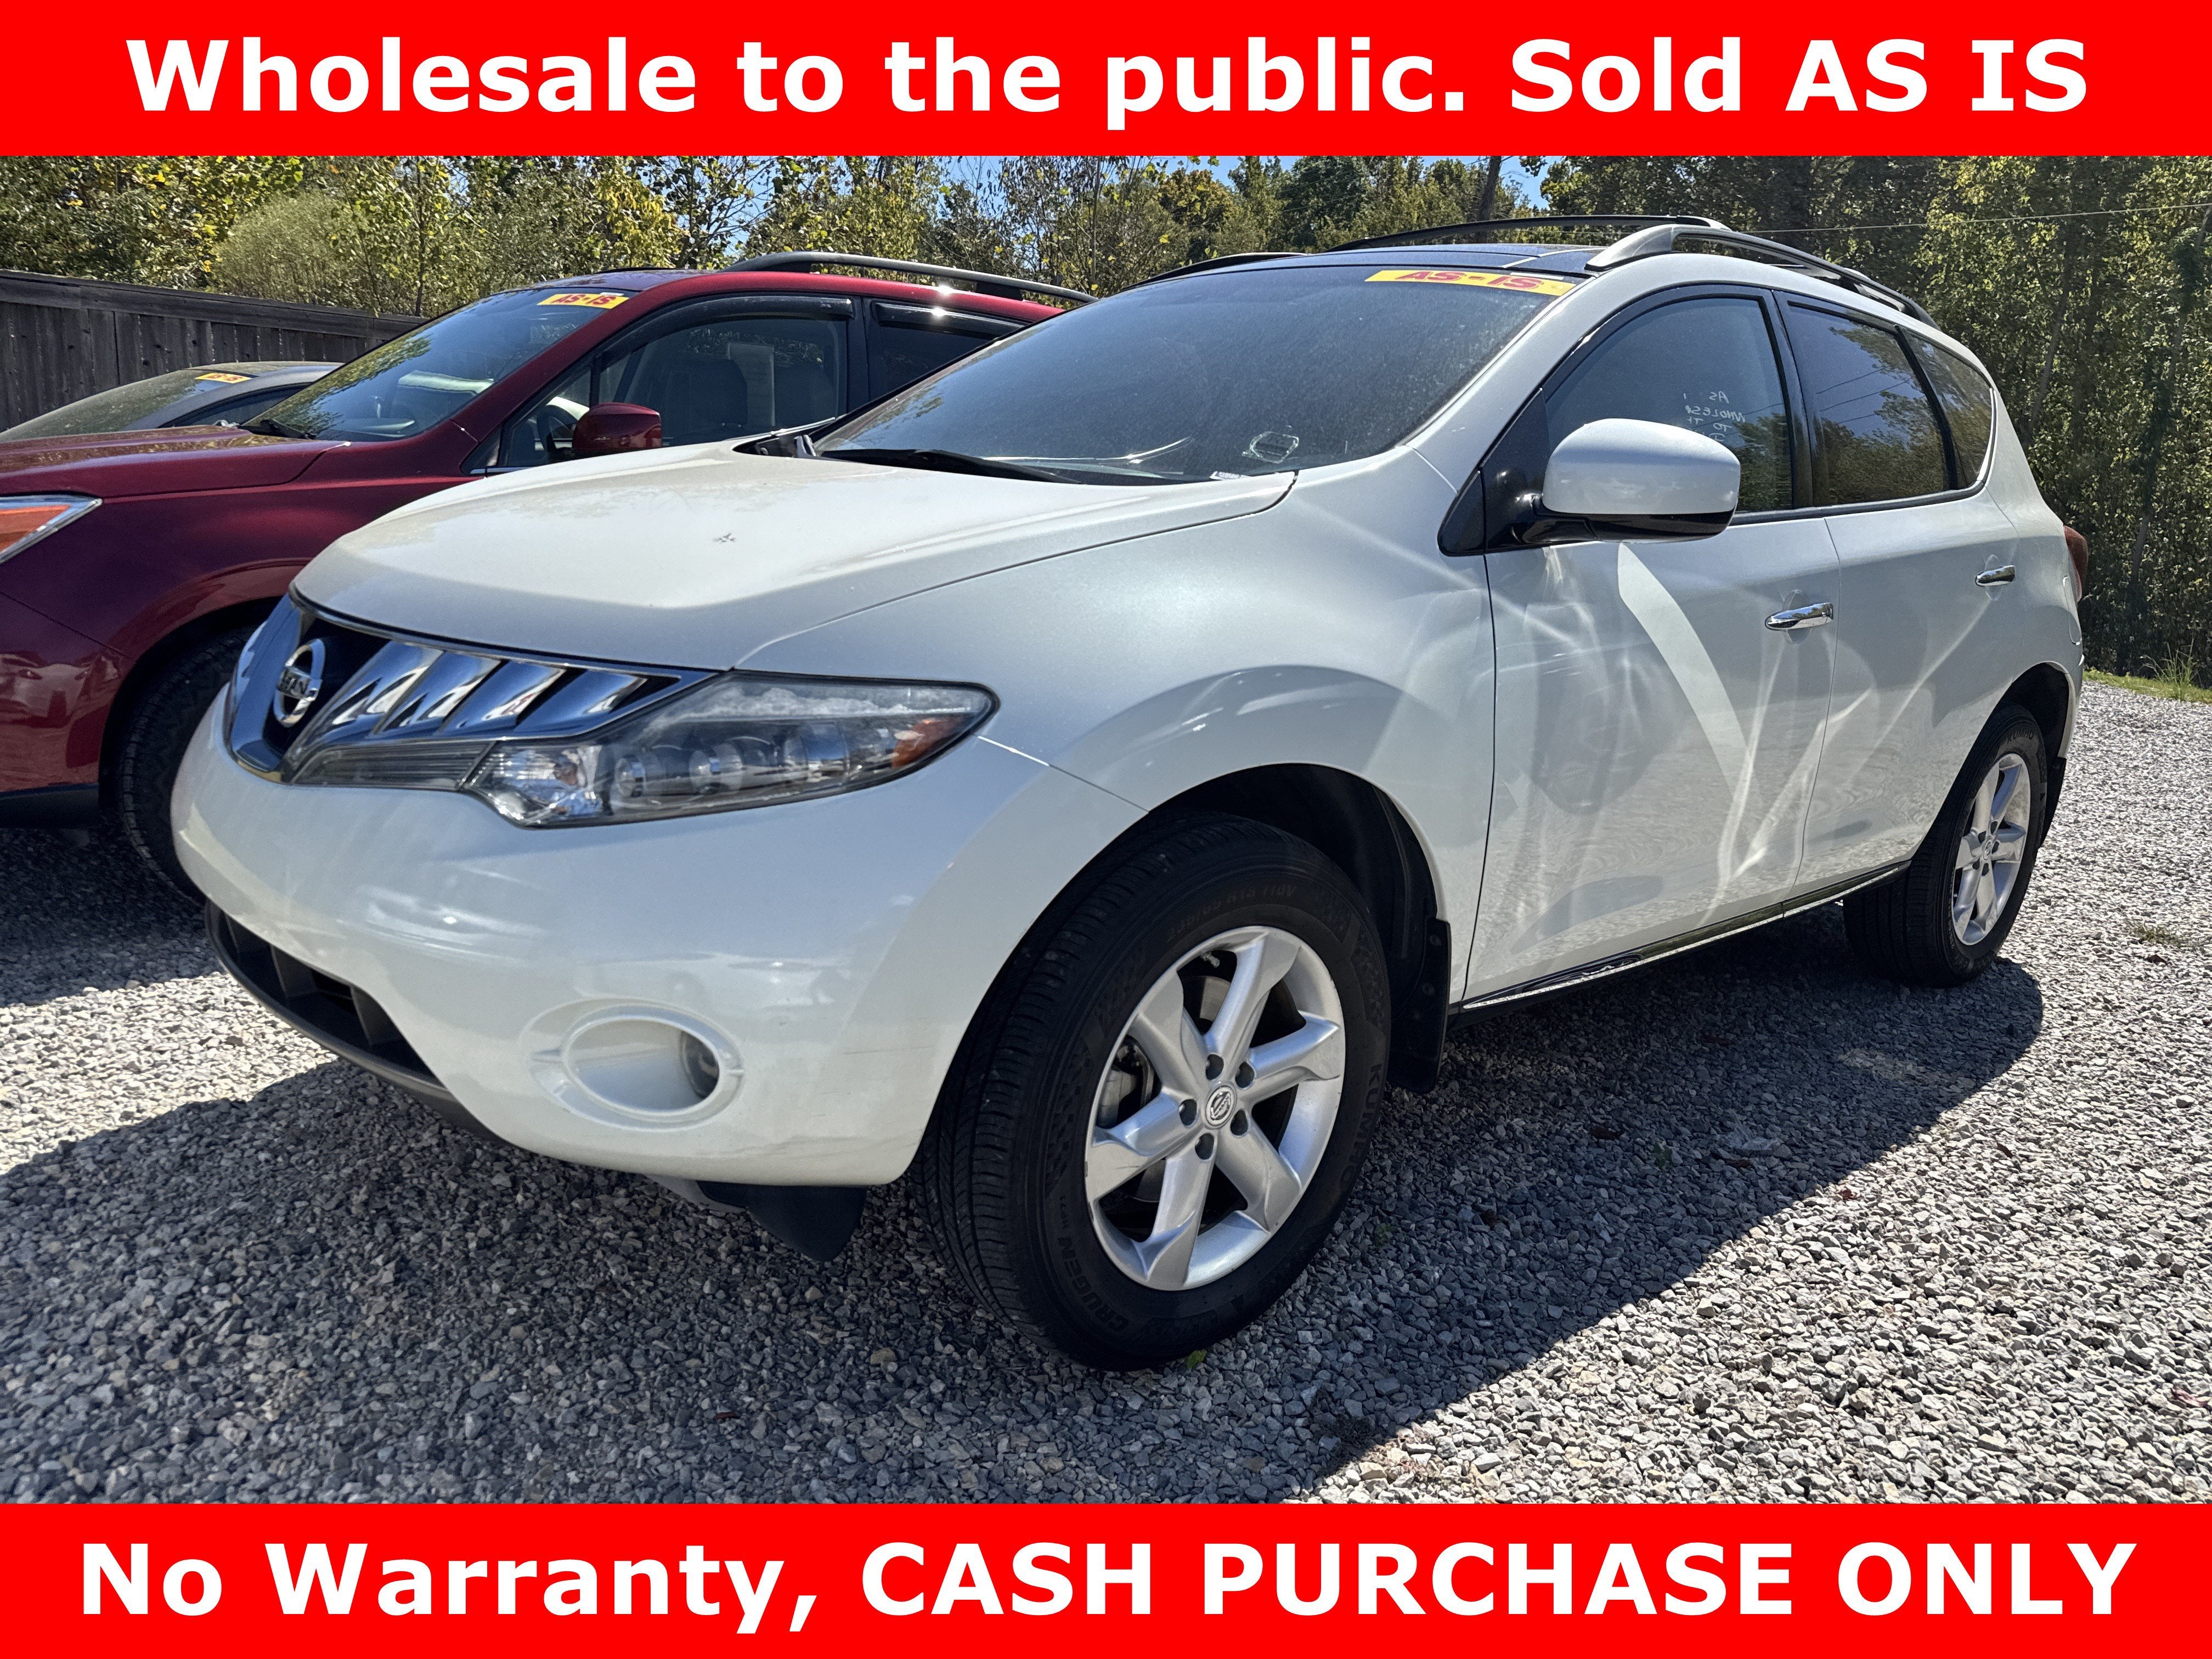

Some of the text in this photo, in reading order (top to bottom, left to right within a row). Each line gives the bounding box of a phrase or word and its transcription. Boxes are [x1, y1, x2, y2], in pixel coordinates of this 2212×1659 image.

[1395, 271, 1545, 290] AS-IS
[550, 294, 616, 305] AS-IS
[1340, 1063, 1383, 1191] KUMHO
